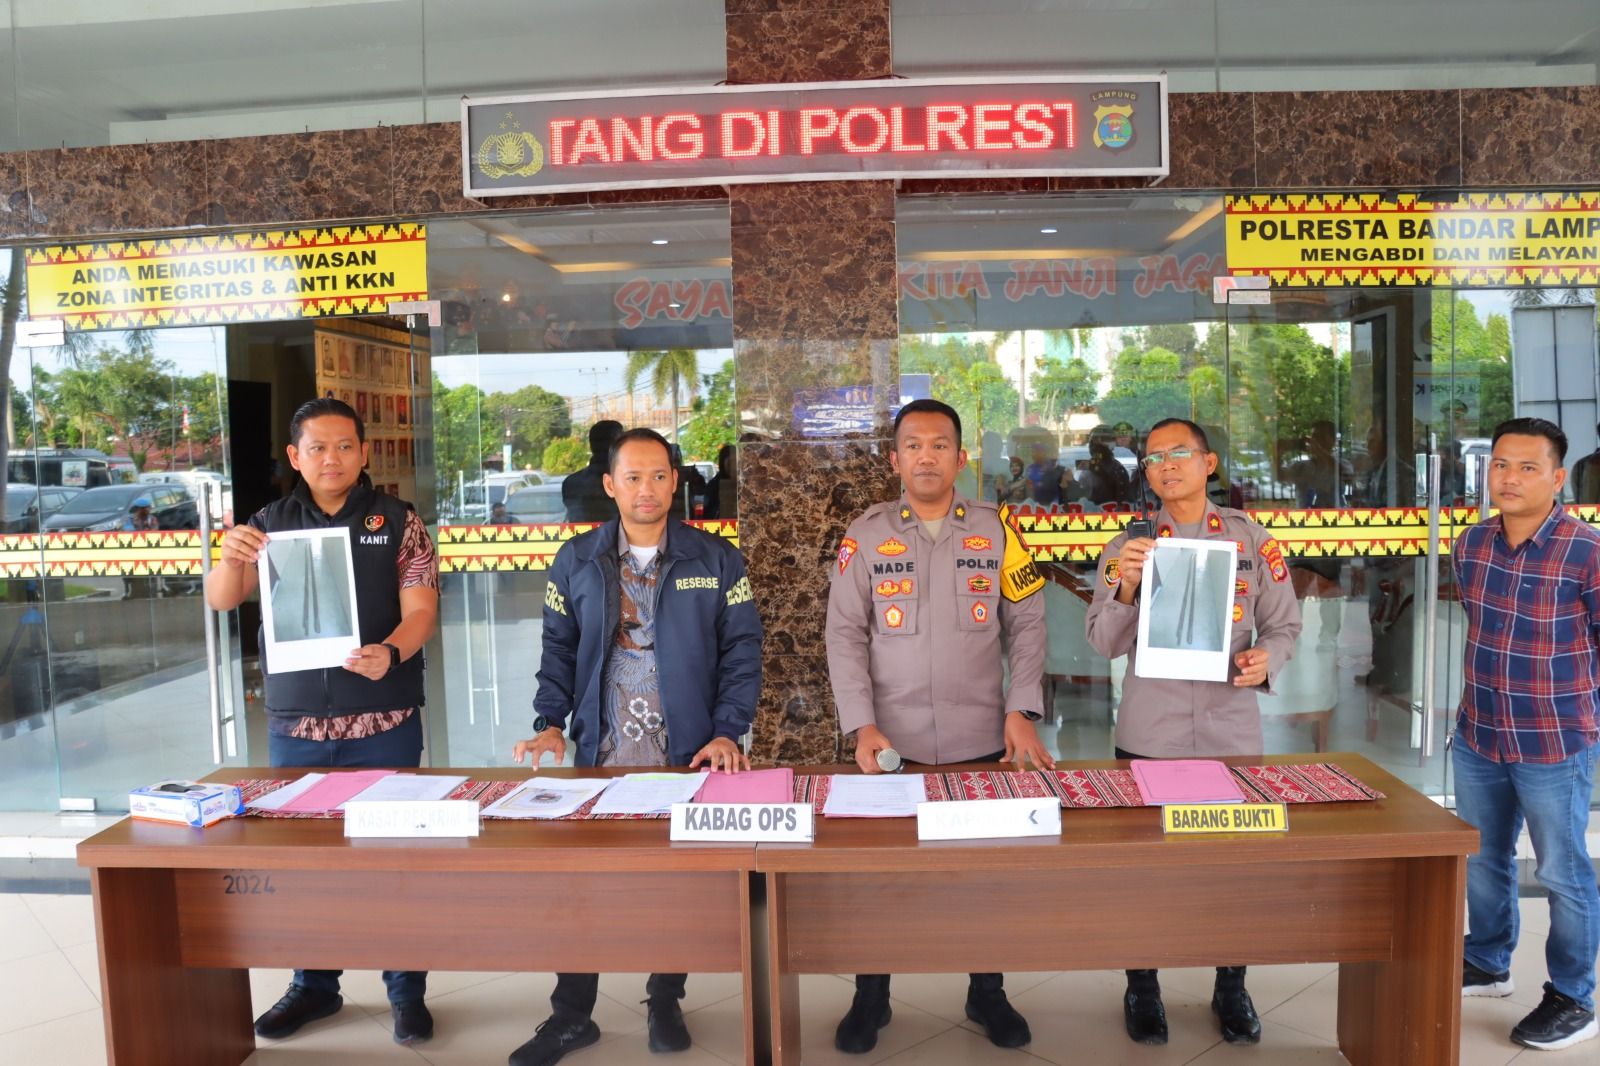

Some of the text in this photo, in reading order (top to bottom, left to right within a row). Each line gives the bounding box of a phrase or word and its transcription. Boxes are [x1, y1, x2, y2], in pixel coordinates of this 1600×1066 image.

[1091, 90, 1137, 102] LAMPUNG
[720, 110, 781, 158] DI
[1240, 219, 1389, 241] POLRESTA
[1399, 217, 1516, 240] BANDAR
[1300, 246, 1598, 262] MENGABDI DAN MELAYAN
[72, 249, 377, 285] ANDA MEMASUKI KAWASAN
[57, 271, 396, 308] ZONA INTEGRITAS & ANTI KKN
[897, 260, 991, 300] KITA
[1004, 257, 1118, 302] JANJI
[613, 276, 733, 329] SAYA
[360, 536, 388, 545] KANIT
[873, 562, 914, 574] MADE
[956, 557, 999, 571] POLRI
[675, 576, 720, 591] RESERSE
[684, 807, 798, 832] KABAG OPS
[1171, 807, 1277, 830] BARANG BUKTI
[223, 874, 277, 895] 2024
